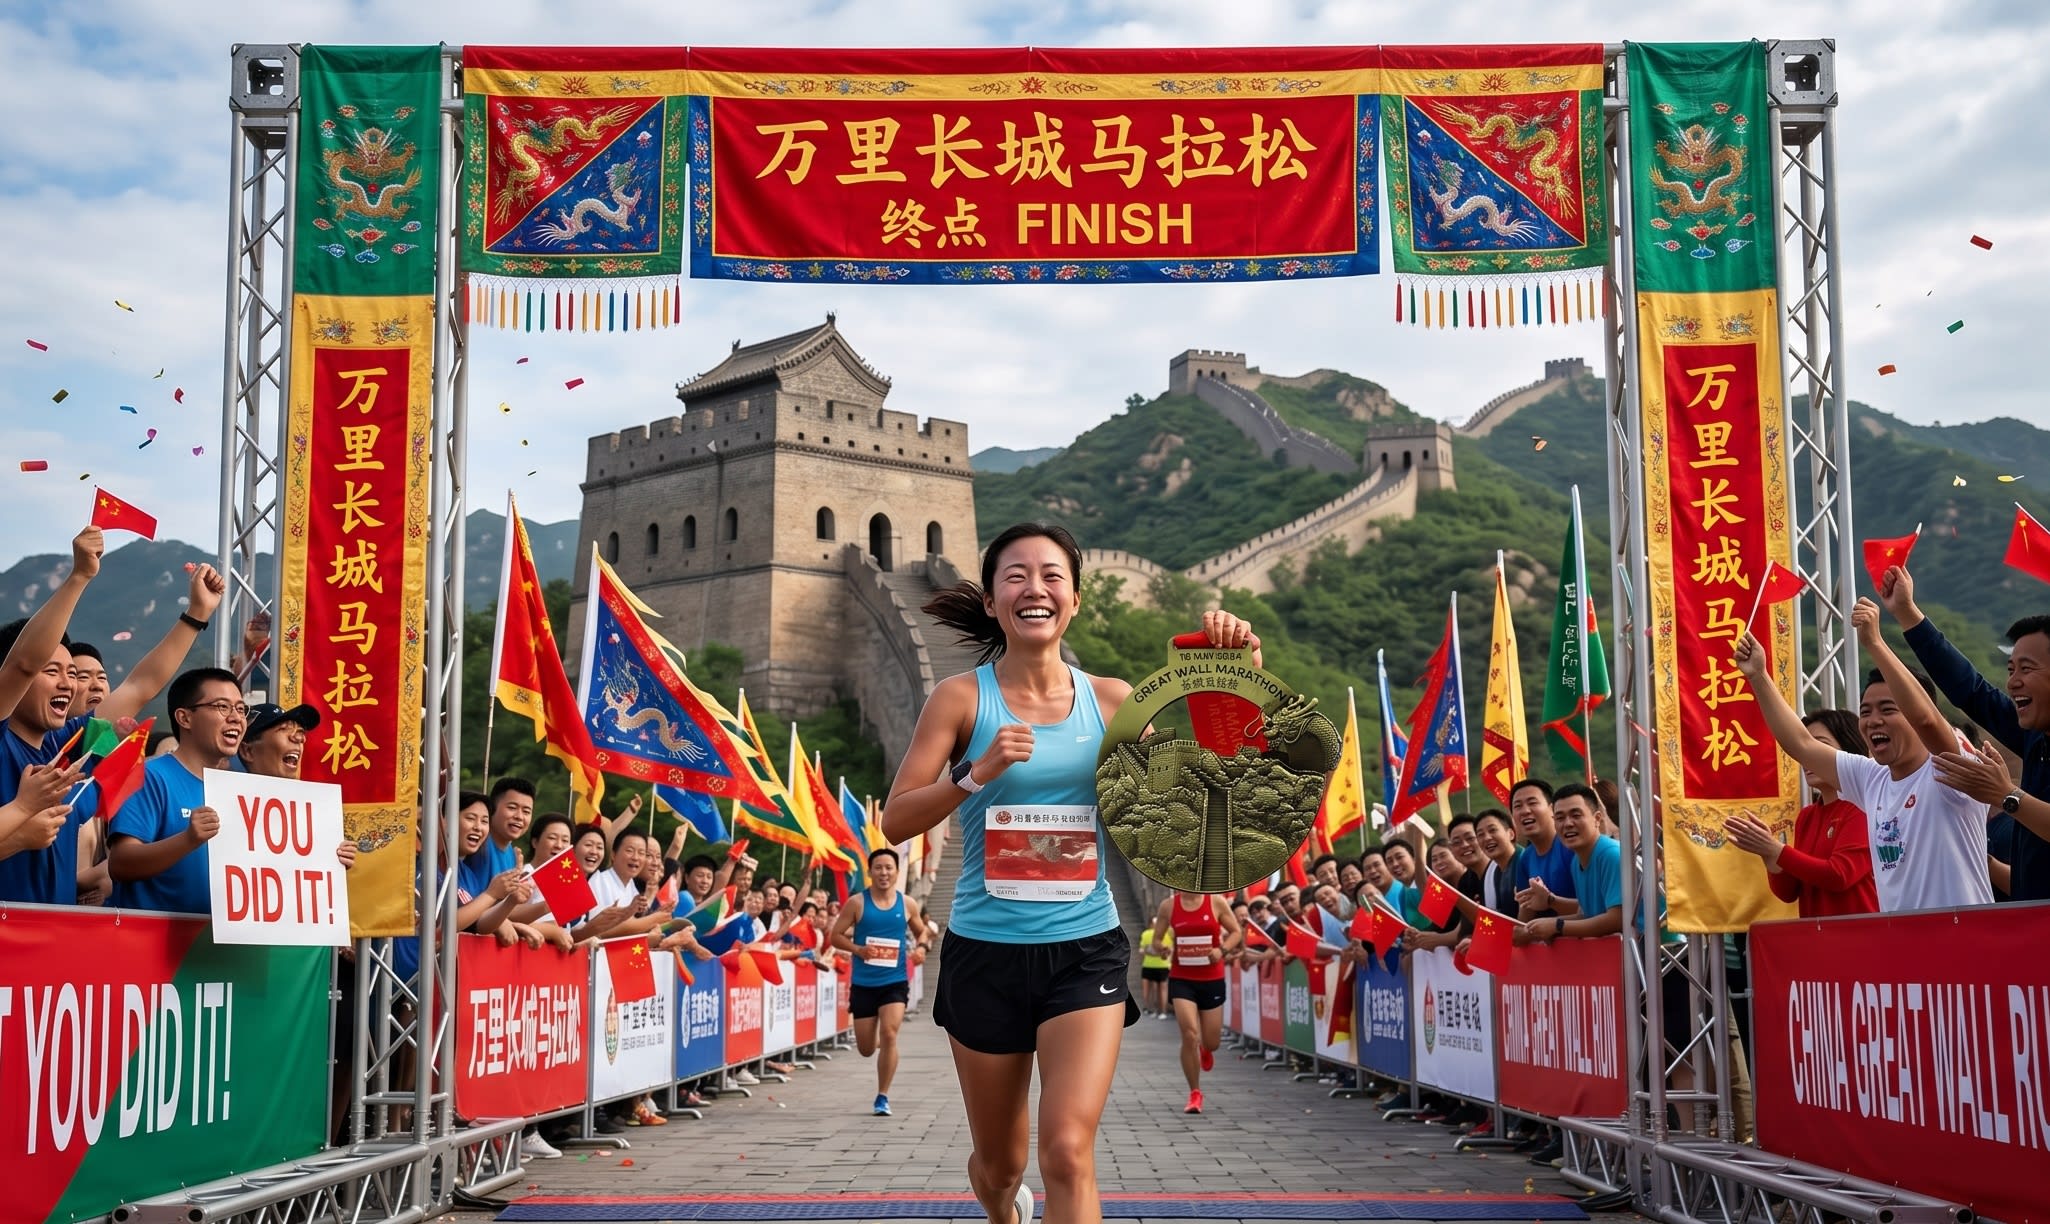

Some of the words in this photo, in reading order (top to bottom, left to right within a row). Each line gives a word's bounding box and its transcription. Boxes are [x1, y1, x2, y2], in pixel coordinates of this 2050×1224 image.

[755, 111, 1317, 189] 万里长城马拉松
[880, 197, 988, 249] 终点
[1018, 203, 1193, 245] FINISH
[320, 367, 389, 776] 万里长城马拉松
[1686, 363, 1759, 772] 万里长城马拉松
[1134, 671, 1172, 703] GREAT
[1174, 664, 1212, 678] WALL
[1215, 664, 1287, 701] MARATHON
[237, 795, 313, 857] YOU
[225, 865, 284, 923] DID
[295, 870, 334, 925] IT!
[24, 983, 111, 1155] YOU
[119, 983, 183, 1139] DID
[192, 982, 233, 1126] IT!
[1502, 984, 1529, 1065] CHINA
[1531, 984, 1559, 1069] GREAT
[1561, 985, 1592, 1075] WALL
[1591, 985, 1618, 1080] RUN
[1788, 980, 1851, 1113] CHINA
[1852, 981, 1925, 1127] GREAT
[1926, 983, 2011, 1144] WALL
